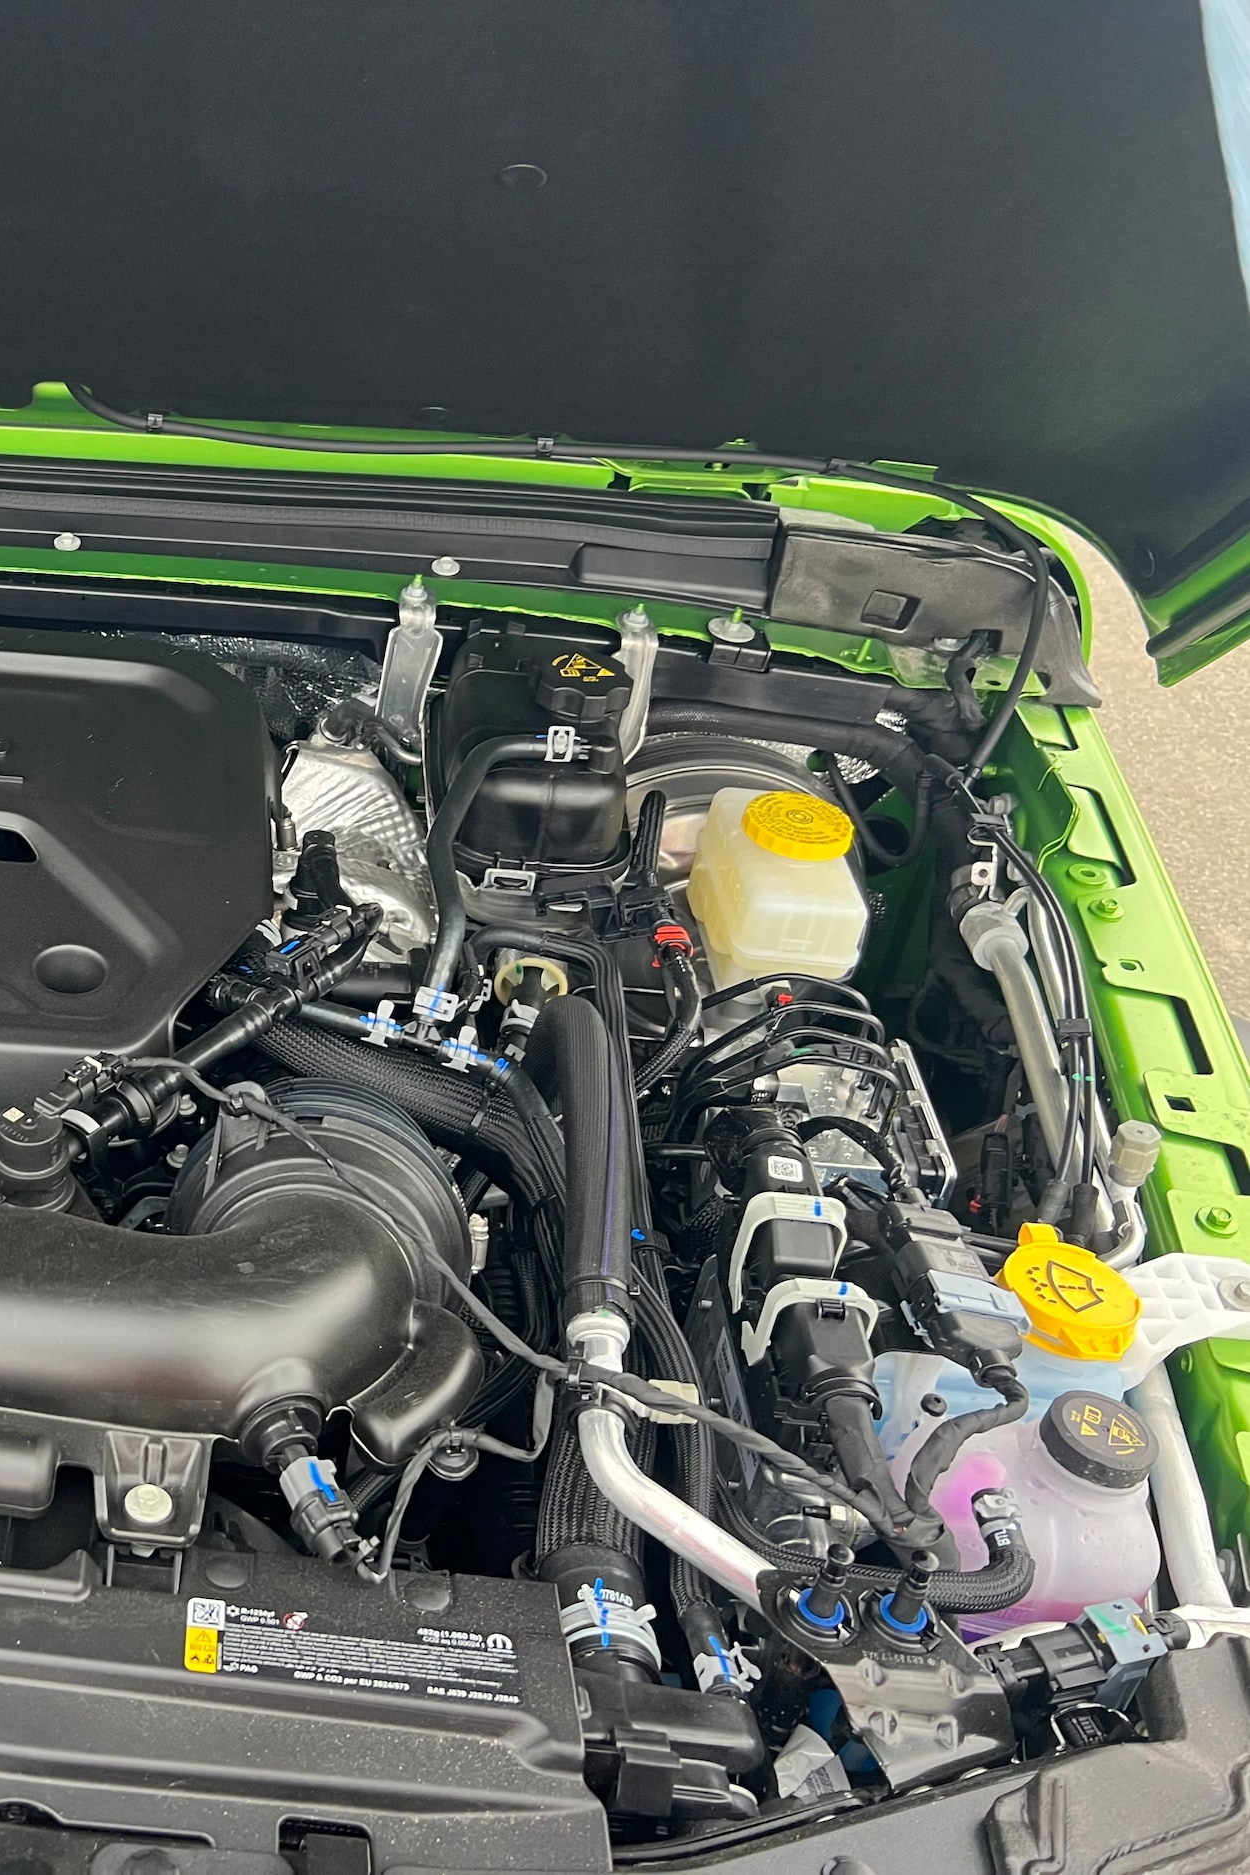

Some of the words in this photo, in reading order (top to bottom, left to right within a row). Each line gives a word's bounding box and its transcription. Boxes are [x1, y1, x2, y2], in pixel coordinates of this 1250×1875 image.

[577, 1588, 633, 1607] 620781AD
[240, 1616, 259, 1624] GWP
[469, 1632, 483, 1643] lb)
[293, 1670, 316, 1680] GWP
[324, 1674, 343, 1683] CO2
[343, 1677, 358, 1685] per
[359, 1678, 372, 1687] EU
[426, 1685, 446, 1695] SAE
